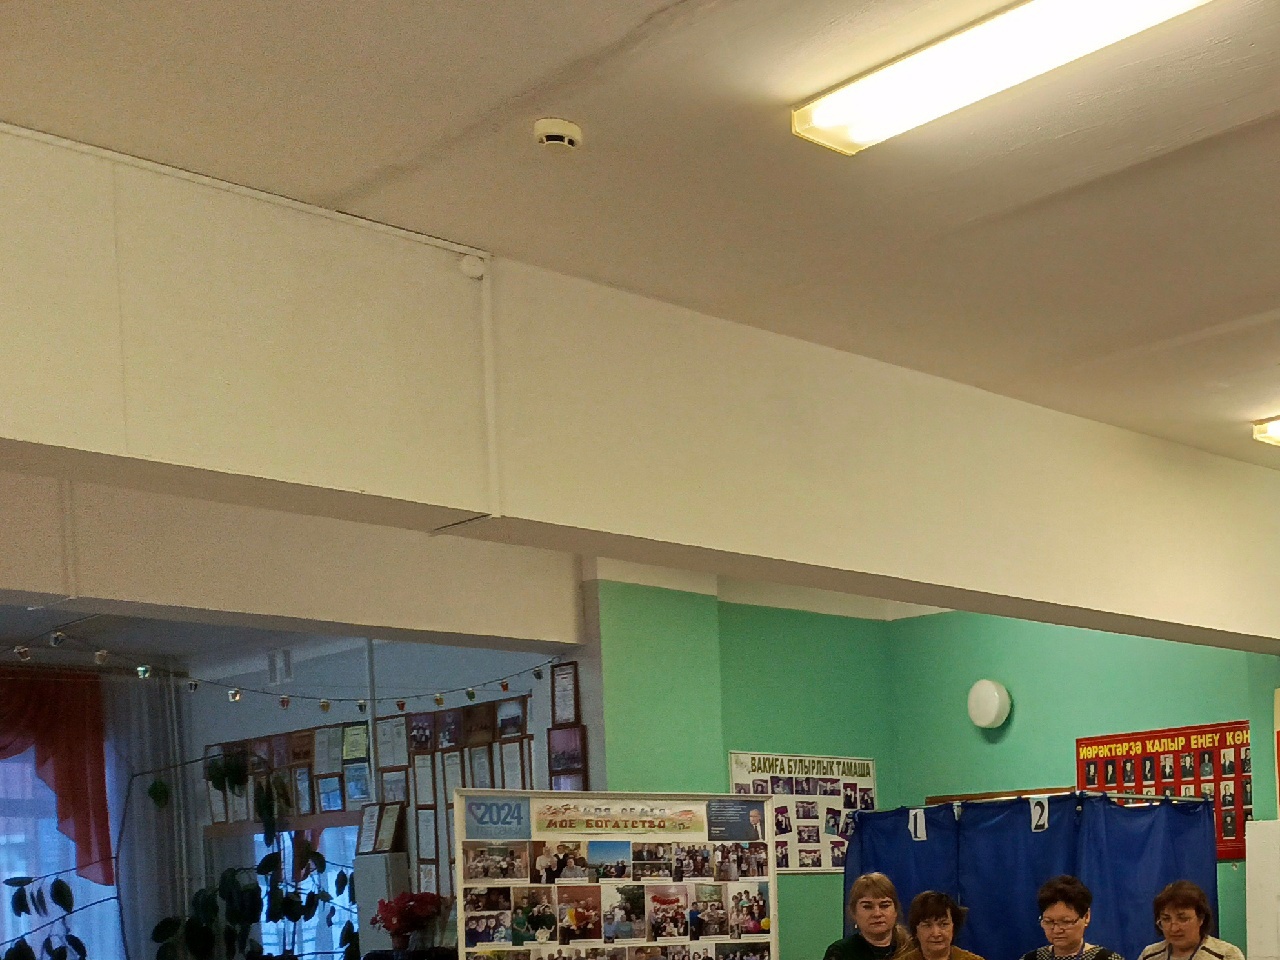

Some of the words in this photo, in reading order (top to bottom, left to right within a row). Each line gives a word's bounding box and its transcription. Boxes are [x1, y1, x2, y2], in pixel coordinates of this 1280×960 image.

[835, 760, 872, 778] ТАМАША
[475, 802, 524, 826] 2024
[545, 819, 577, 829] МОЕ
[585, 819, 666, 829] БОГАТСТВО
[911, 811, 921, 839] 1
[1033, 800, 1046, 831] 2
